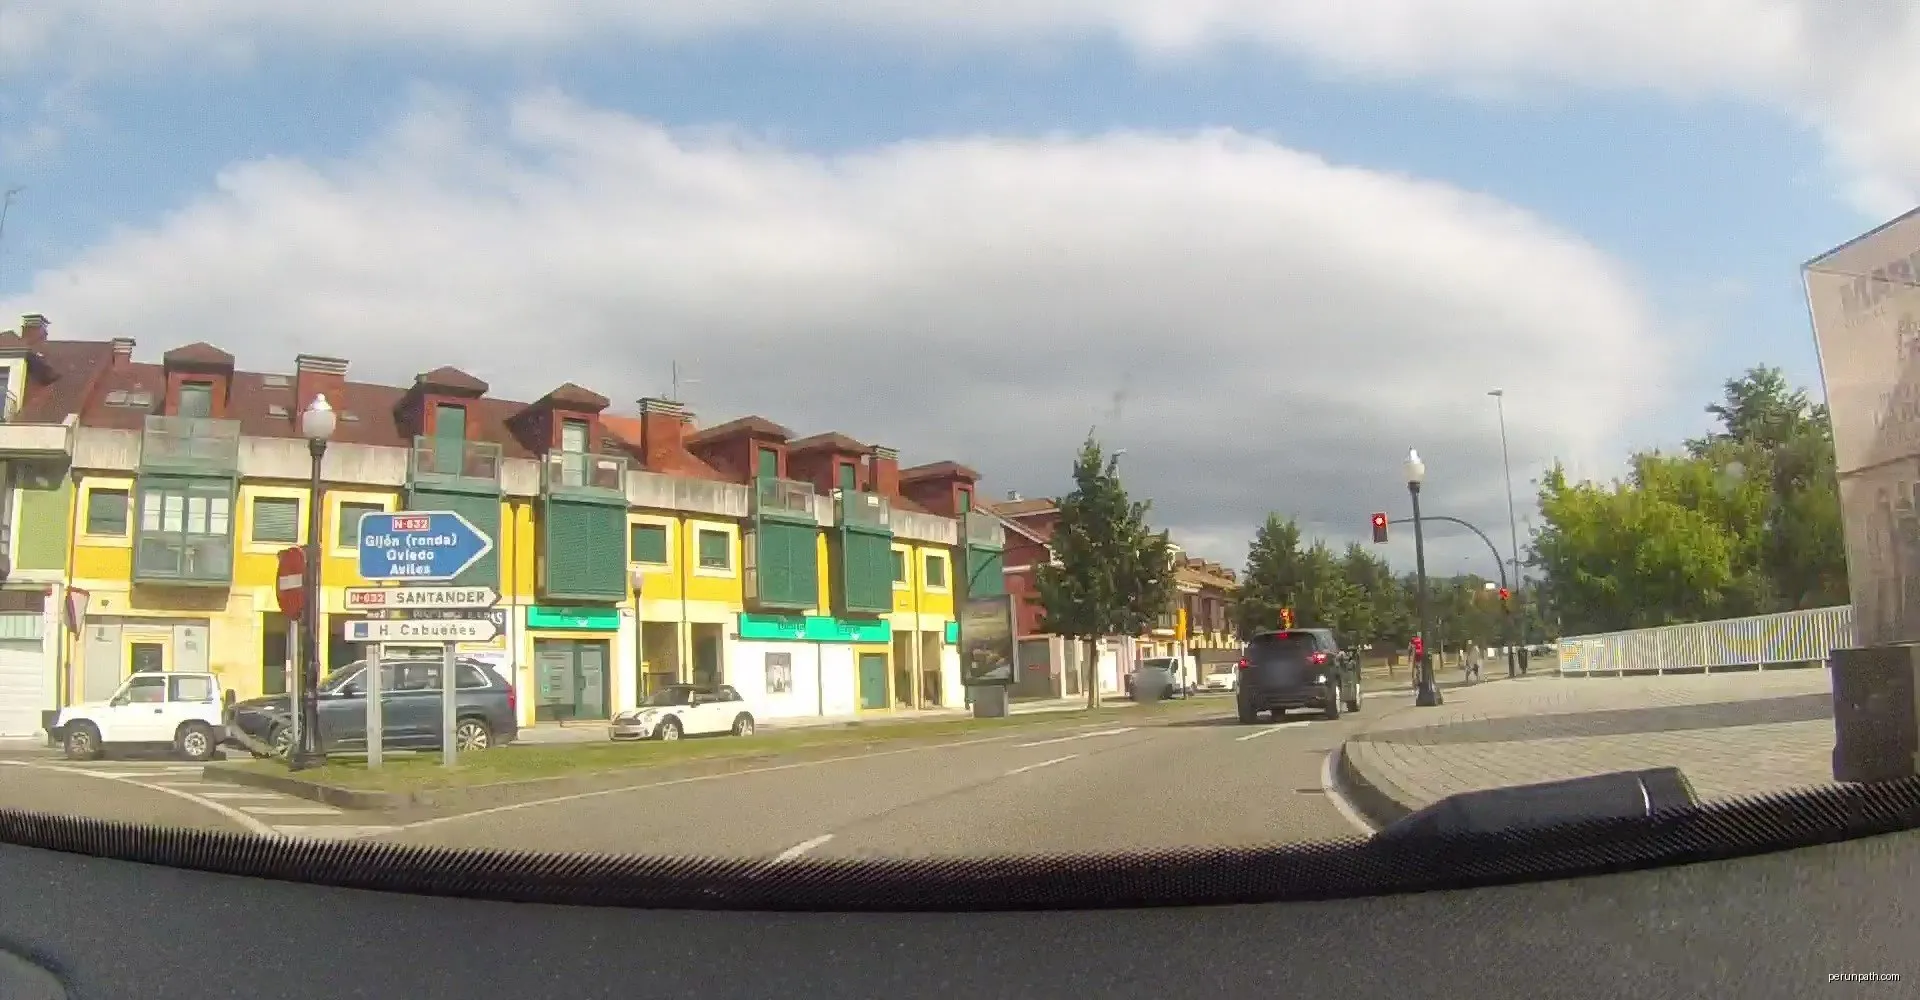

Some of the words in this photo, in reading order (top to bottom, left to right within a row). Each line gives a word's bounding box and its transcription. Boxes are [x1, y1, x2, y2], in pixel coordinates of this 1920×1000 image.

[365, 533, 400, 548] Gijón
[406, 533, 457, 546] (ronda)
[386, 549, 434, 560] Oviedo
[396, 591, 485, 603] SANTANDER
